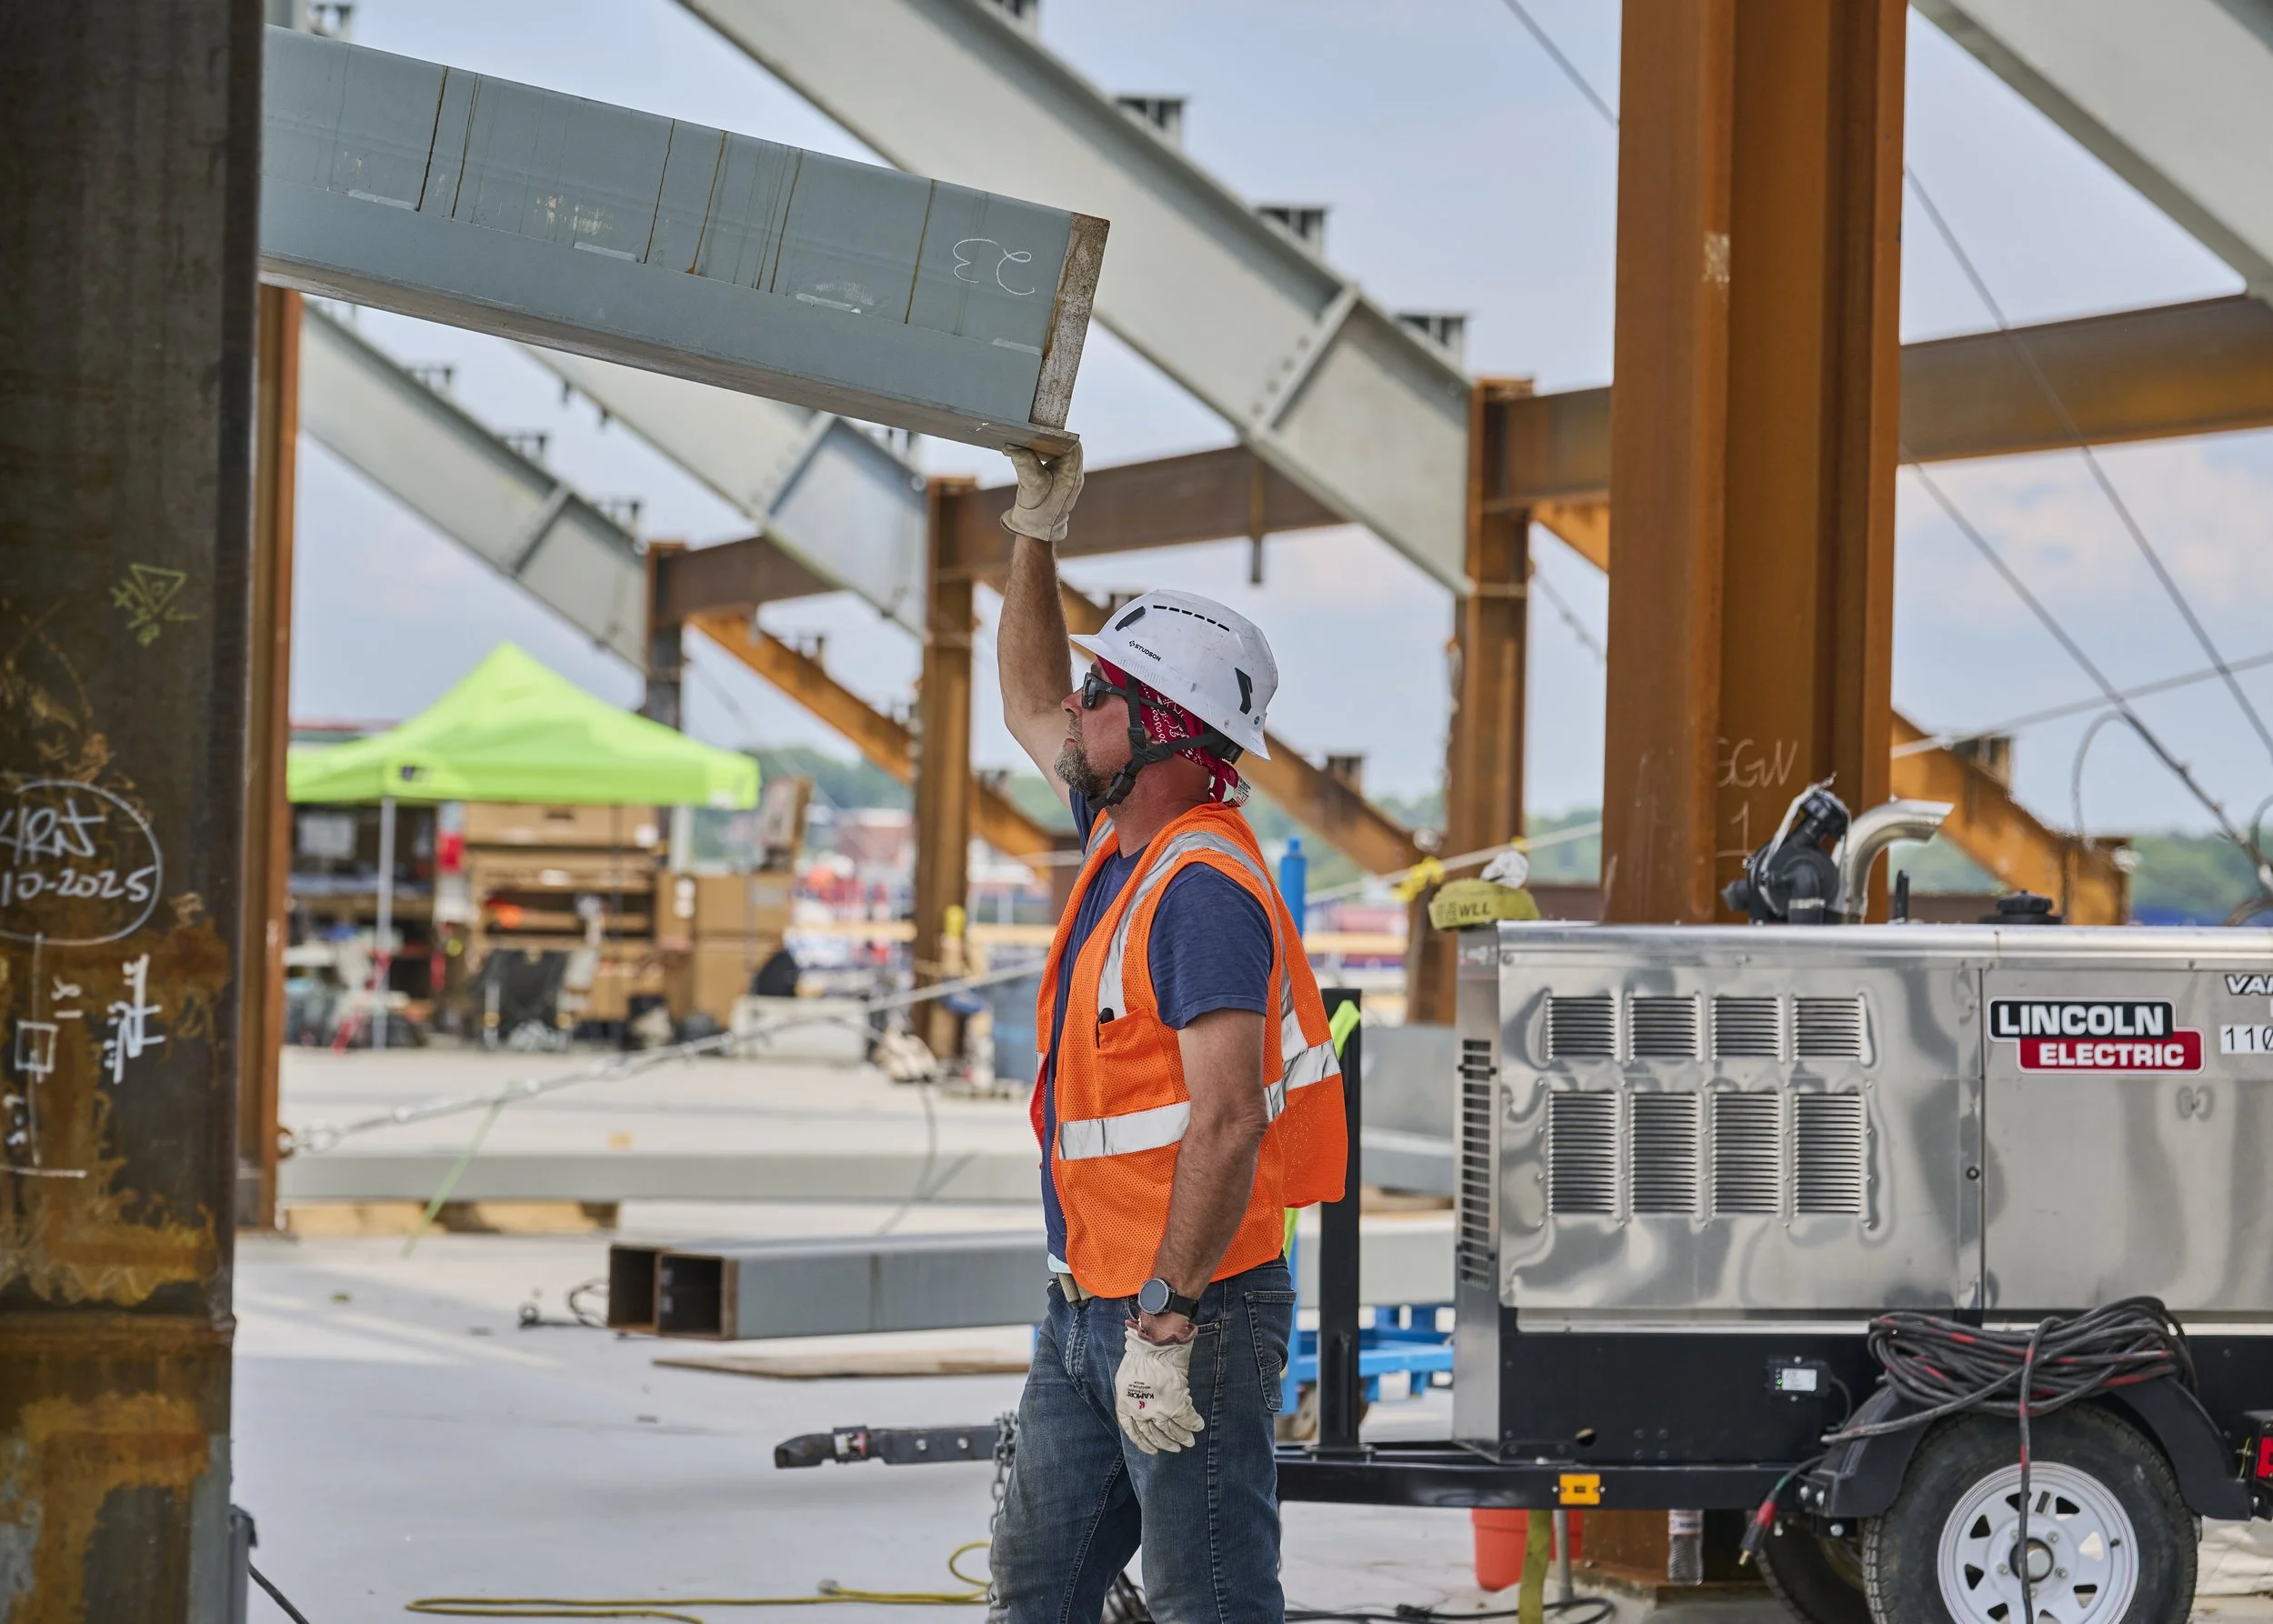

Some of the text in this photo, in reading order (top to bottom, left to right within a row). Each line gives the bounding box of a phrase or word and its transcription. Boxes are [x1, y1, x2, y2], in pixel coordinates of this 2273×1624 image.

[1134, 643, 1162, 662] STUDSON
[1999, 1005, 2163, 1036] LINCOLN
[2039, 1042, 2184, 1067] ELECTRIC
